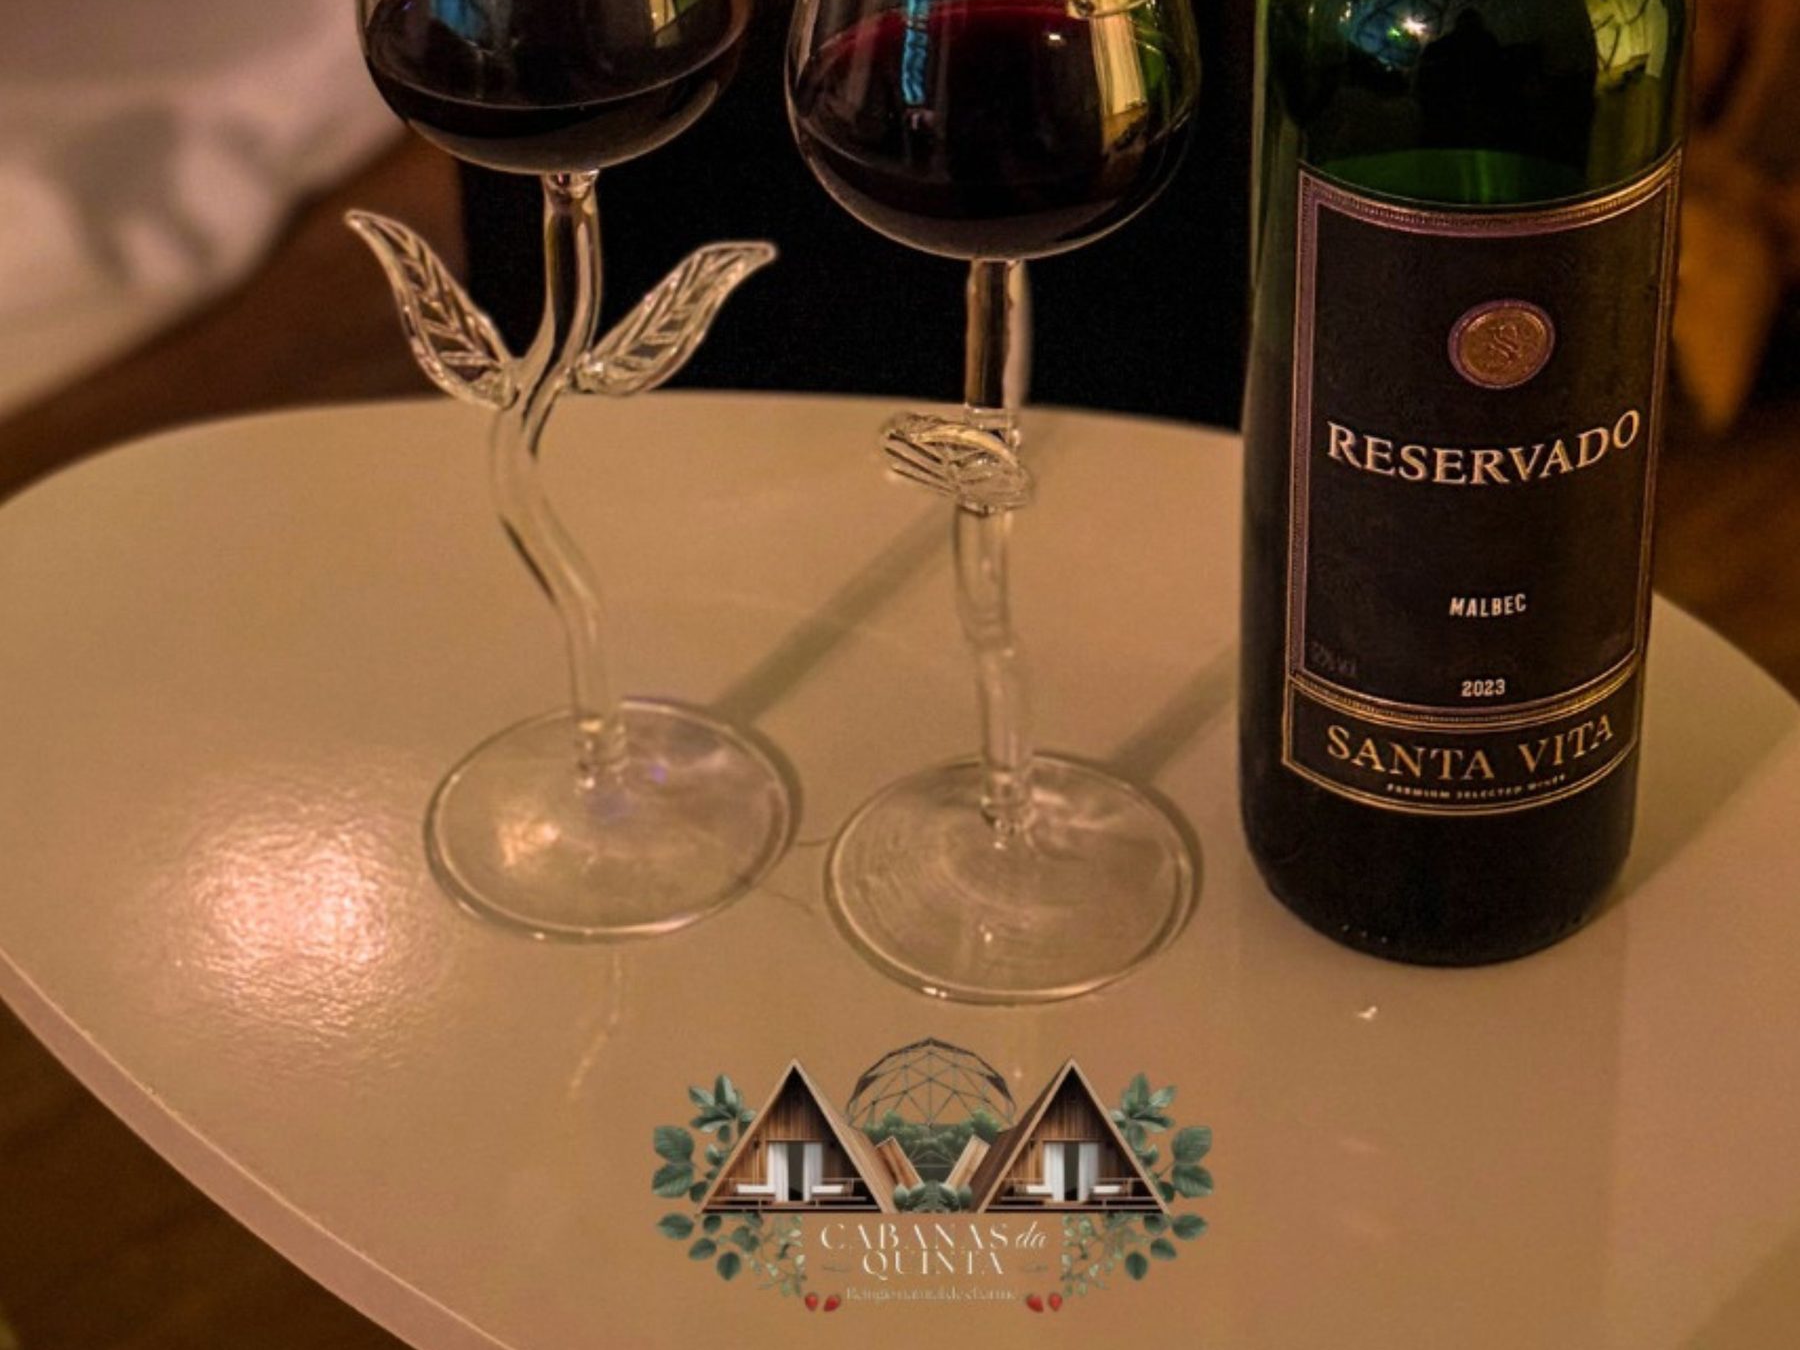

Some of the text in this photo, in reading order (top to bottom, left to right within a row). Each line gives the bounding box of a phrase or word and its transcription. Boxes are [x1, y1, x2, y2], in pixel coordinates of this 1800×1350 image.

[1327, 409, 1640, 486] RESERVADO
[1449, 593, 1526, 617] MALBEC
[1461, 678, 1506, 697] 2023
[1327, 713, 1614, 782] SANTA VITA
